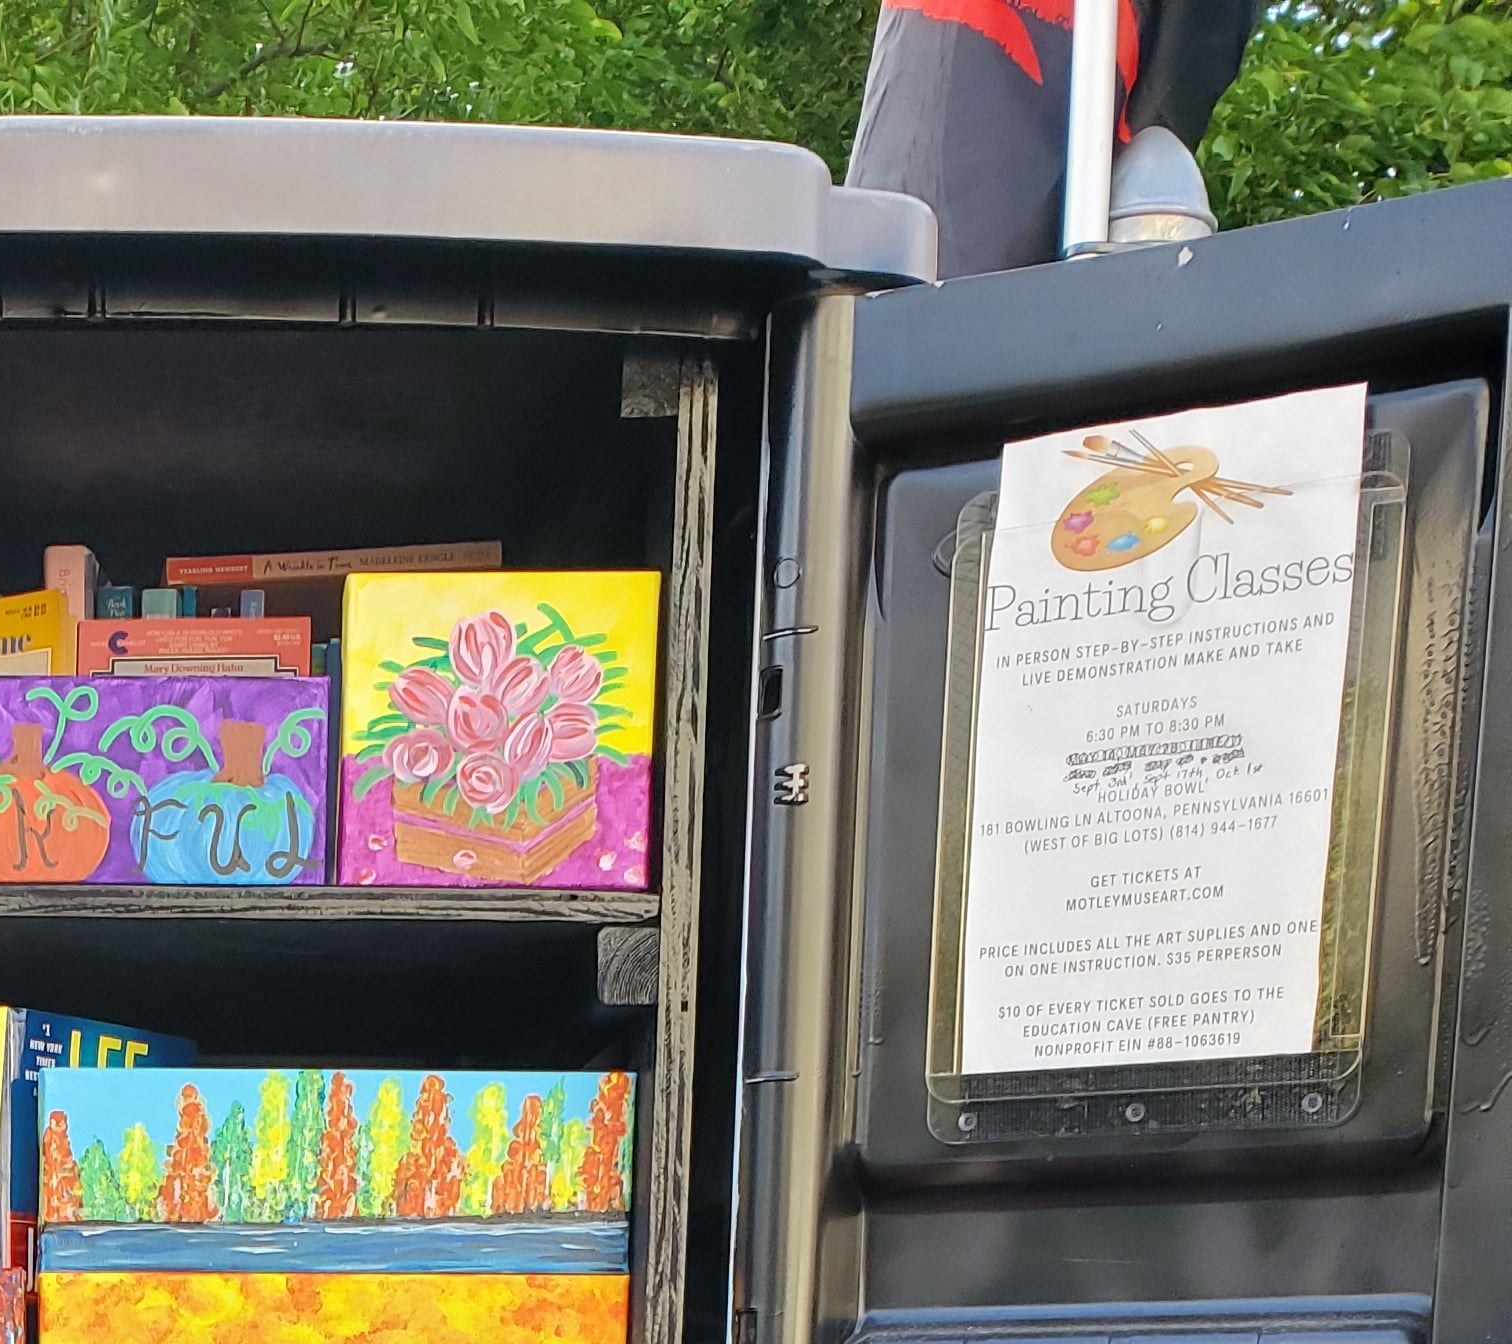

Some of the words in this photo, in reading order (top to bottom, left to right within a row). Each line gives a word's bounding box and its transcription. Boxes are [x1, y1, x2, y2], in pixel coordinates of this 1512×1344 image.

[985, 576, 1175, 632] Painting
[1188, 552, 1354, 604] Classes
[996, 655, 1010, 669] IN
[1016, 648, 1070, 667] PERSON
[1076, 634, 1184, 659] STEP-BY-STEP
[1189, 617, 1297, 645] INSTRUCTIONS
[1303, 612, 1335, 630] AND
[144, 664, 170, 675] Mary
[171, 663, 215, 675] Downing
[217, 663, 244, 673] Hahn
[1022, 671, 1051, 686] LIVE
[1057, 655, 1178, 682] DEMONSTRATION
[1184, 649, 1224, 665] MAKE
[1229, 643, 1262, 661] AND
[1266, 639, 1303, 656] TAKE
[1116, 696, 1198, 718] SATURDAYS
[1086, 728, 1115, 743] 6:30
[1120, 724, 1140, 739] PM
[1146, 721, 1164, 735] TO
[1169, 717, 1199, 732] 8:30
[1205, 713, 1225, 729] PM
[1098, 785, 1159, 803] HOLIDAY
[1164, 782, 1204, 797] BOWL
[980, 823, 1000, 837] 181
[1005, 815, 1069, 834] BOWLING
[1074, 812, 1092, 826] LN
[1097, 805, 1167, 825] ALTOONA,
[1173, 793, 1283, 817] PENNSYLVANIA
[1289, 788, 1328, 805] 16601
[1024, 836, 1066, 854] (WEST
[1071, 834, 1089, 848] OF
[1095, 831, 1118, 846] BIG
[1124, 825, 1164, 843] LOTS)
[1170, 821, 1205, 840] (814)
[1211, 816, 1278, 835] 944-1677
[1090, 874, 1116, 888] GET
[1122, 869, 1179, 884] TICKETS
[1183, 866, 1202, 879] AT
[1066, 885, 1224, 912] MOTLEYMUSEART.COM
[979, 945, 1019, 959] PRICE
[1024, 939, 1092, 956] INCLUDES
[1096, 937, 1120, 950] ALL
[1126, 934, 1151, 948] THE
[1156, 931, 1182, 945] ART
[1187, 926, 1245, 943] SUPLIES
[1250, 922, 1281, 938] AND
[1287, 920, 1318, 934] ONE
[1005, 964, 1024, 978] ON
[1030, 961, 1058, 976] ONE
[1064, 954, 1161, 973] INSTRUCTION.
[1166, 951, 1191, 966] $35
[1197, 944, 1282, 962] PERPERSON
[998, 1005, 1020, 1020] $10
[1026, 1003, 1044, 1017] OF
[1048, 1000, 1091, 1016] EVERY
[1096, 997, 1144, 1013] TICKET
[1149, 994, 1185, 1009] SOLD
[1190, 990, 1228, 1006] GOES
[1233, 988, 1252, 1002] TO
[1257, 986, 1284, 1000] THE
[1022, 1021, 1102, 1038] EDUCATION
[1106, 1018, 1143, 1032] CAVE
[1148, 1014, 1188, 1031] (FREE
[1192, 1009, 1255, 1027] PANTRY)
[1034, 1040, 1114, 1058] NONPROFIT
[1118, 1038, 1142, 1052] EIN
[1147, 1032, 1240, 1050] #88-1063619
